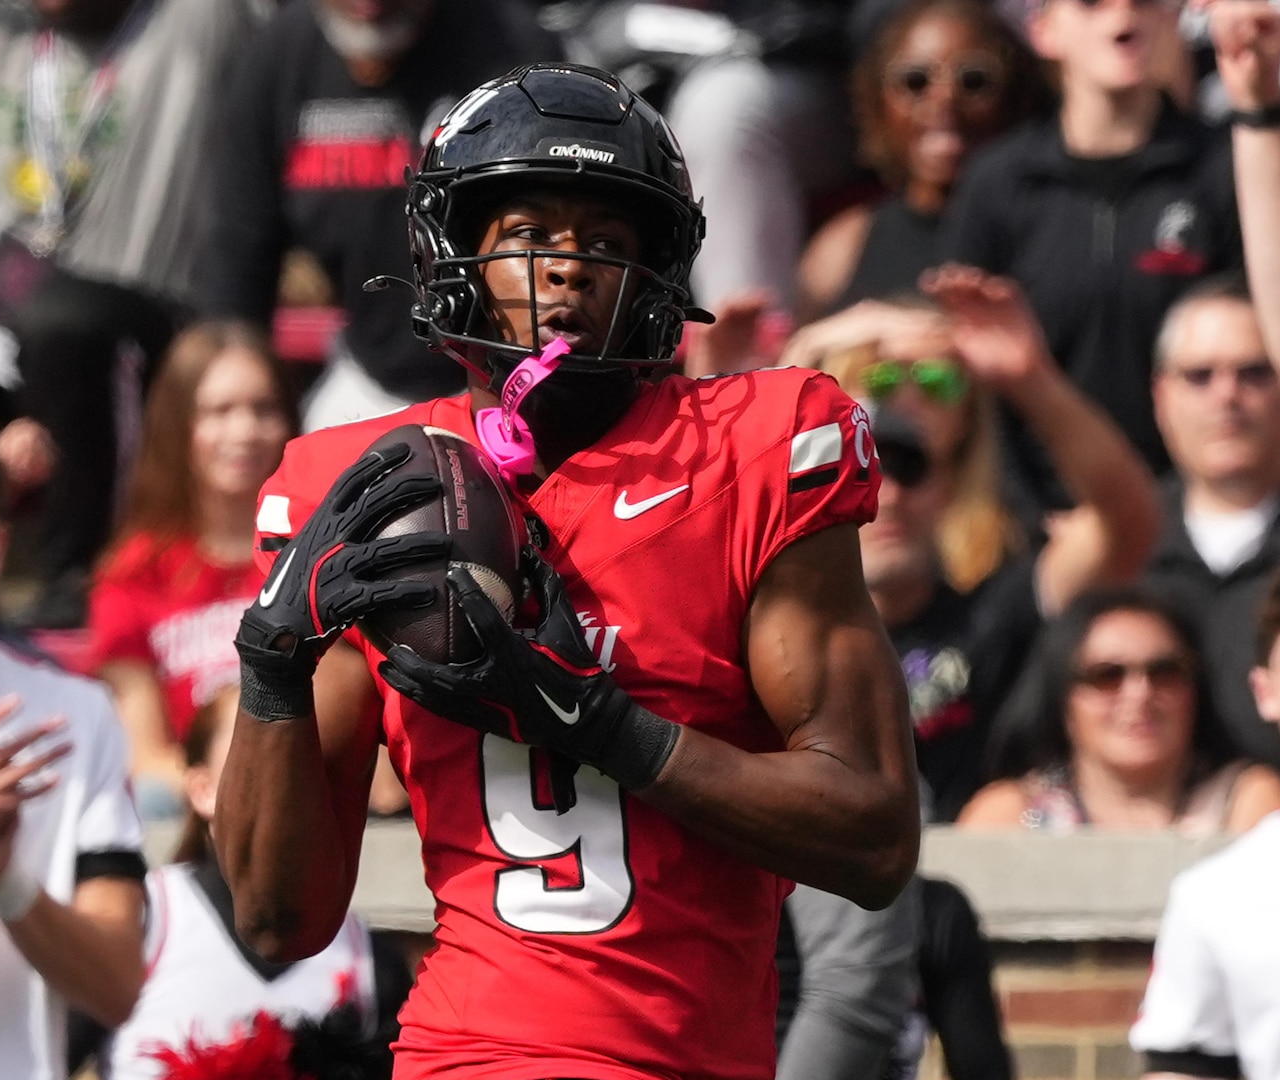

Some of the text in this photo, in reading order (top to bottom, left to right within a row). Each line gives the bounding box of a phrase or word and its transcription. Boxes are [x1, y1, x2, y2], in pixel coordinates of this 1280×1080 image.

[549, 145, 615, 163] CINCINNATI
[454, 483, 469, 531] ELITE
[479, 731, 635, 935] 9
